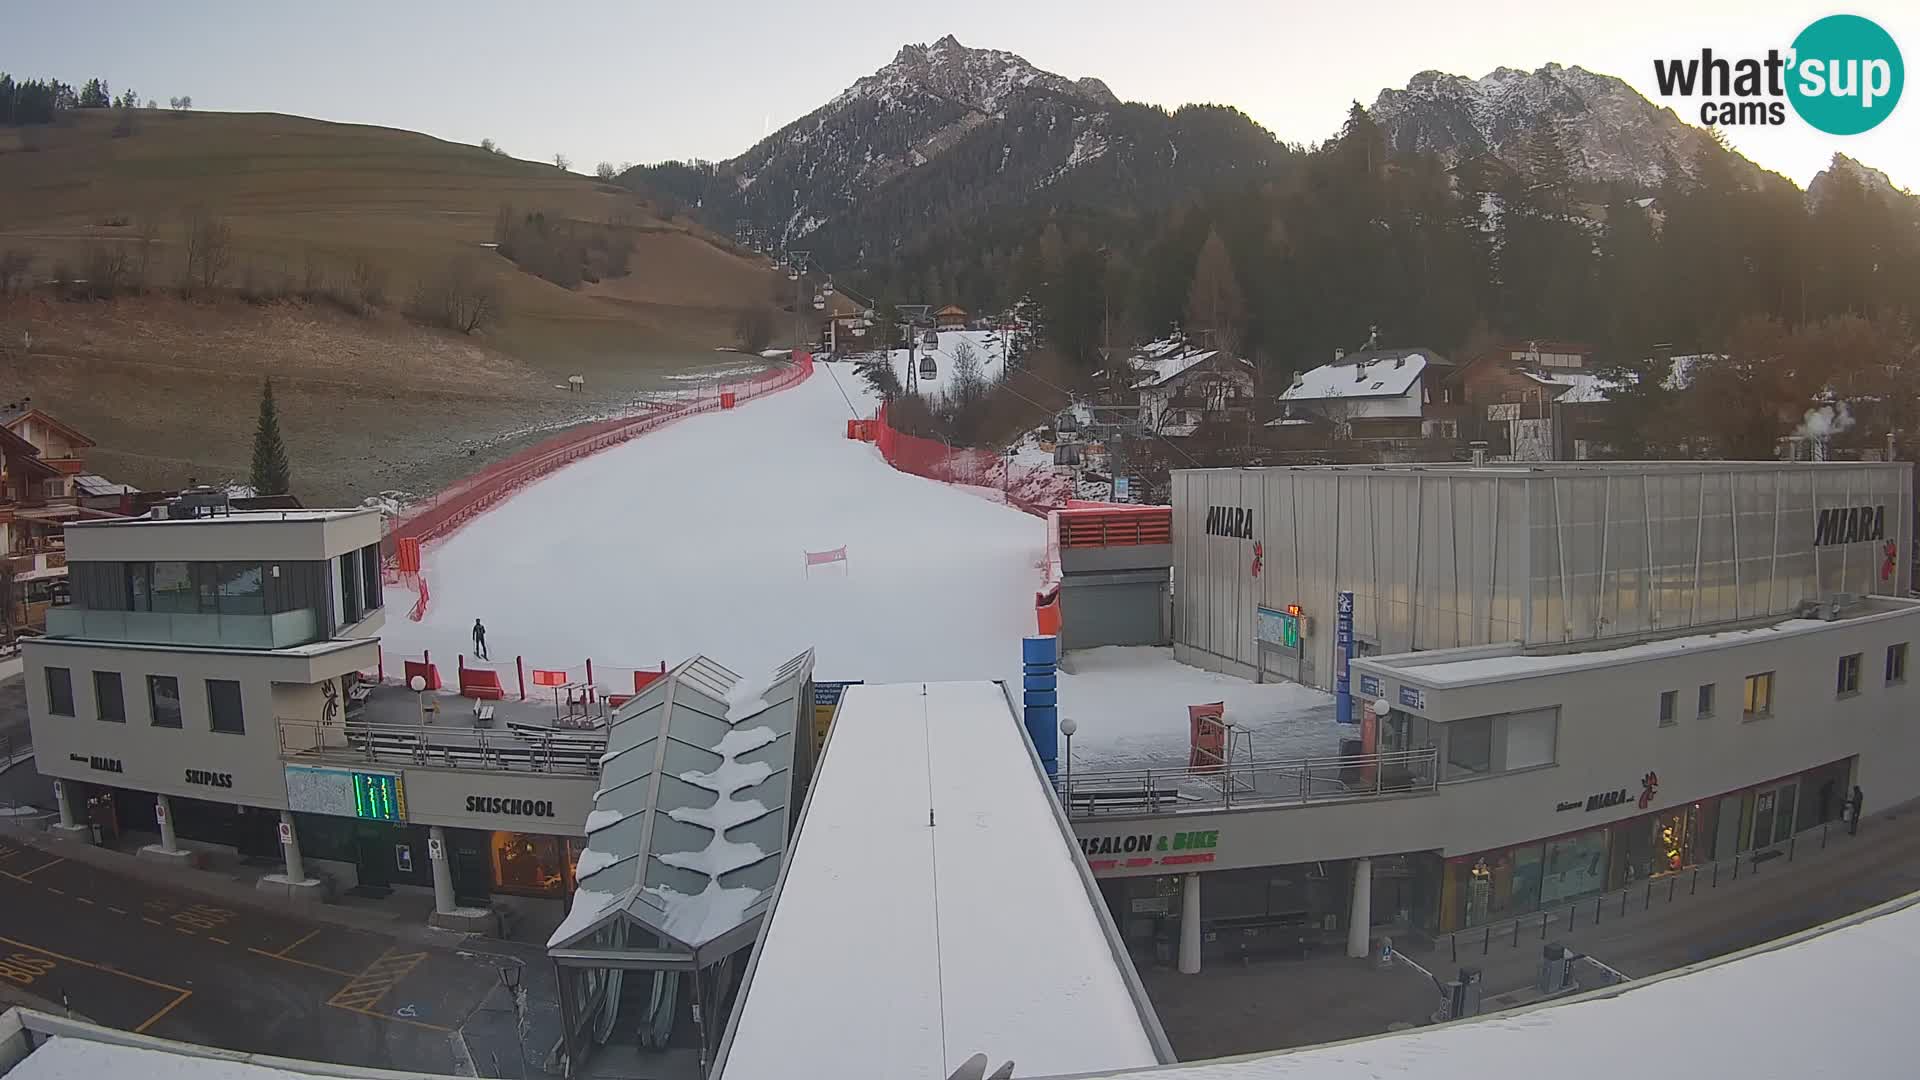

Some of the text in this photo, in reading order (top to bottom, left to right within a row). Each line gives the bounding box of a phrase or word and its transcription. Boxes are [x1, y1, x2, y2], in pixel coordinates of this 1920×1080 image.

[1206, 505, 1253, 540] MIARA
[1814, 505, 1884, 546] MIARA
[90, 755, 123, 773] MIARA
[184, 769, 233, 788] SKIPASS
[466, 795, 555, 818] SKISCHOOL
[1585, 788, 1626, 812] MIARA
[1077, 829, 1219, 856] ISALON & BIKE
